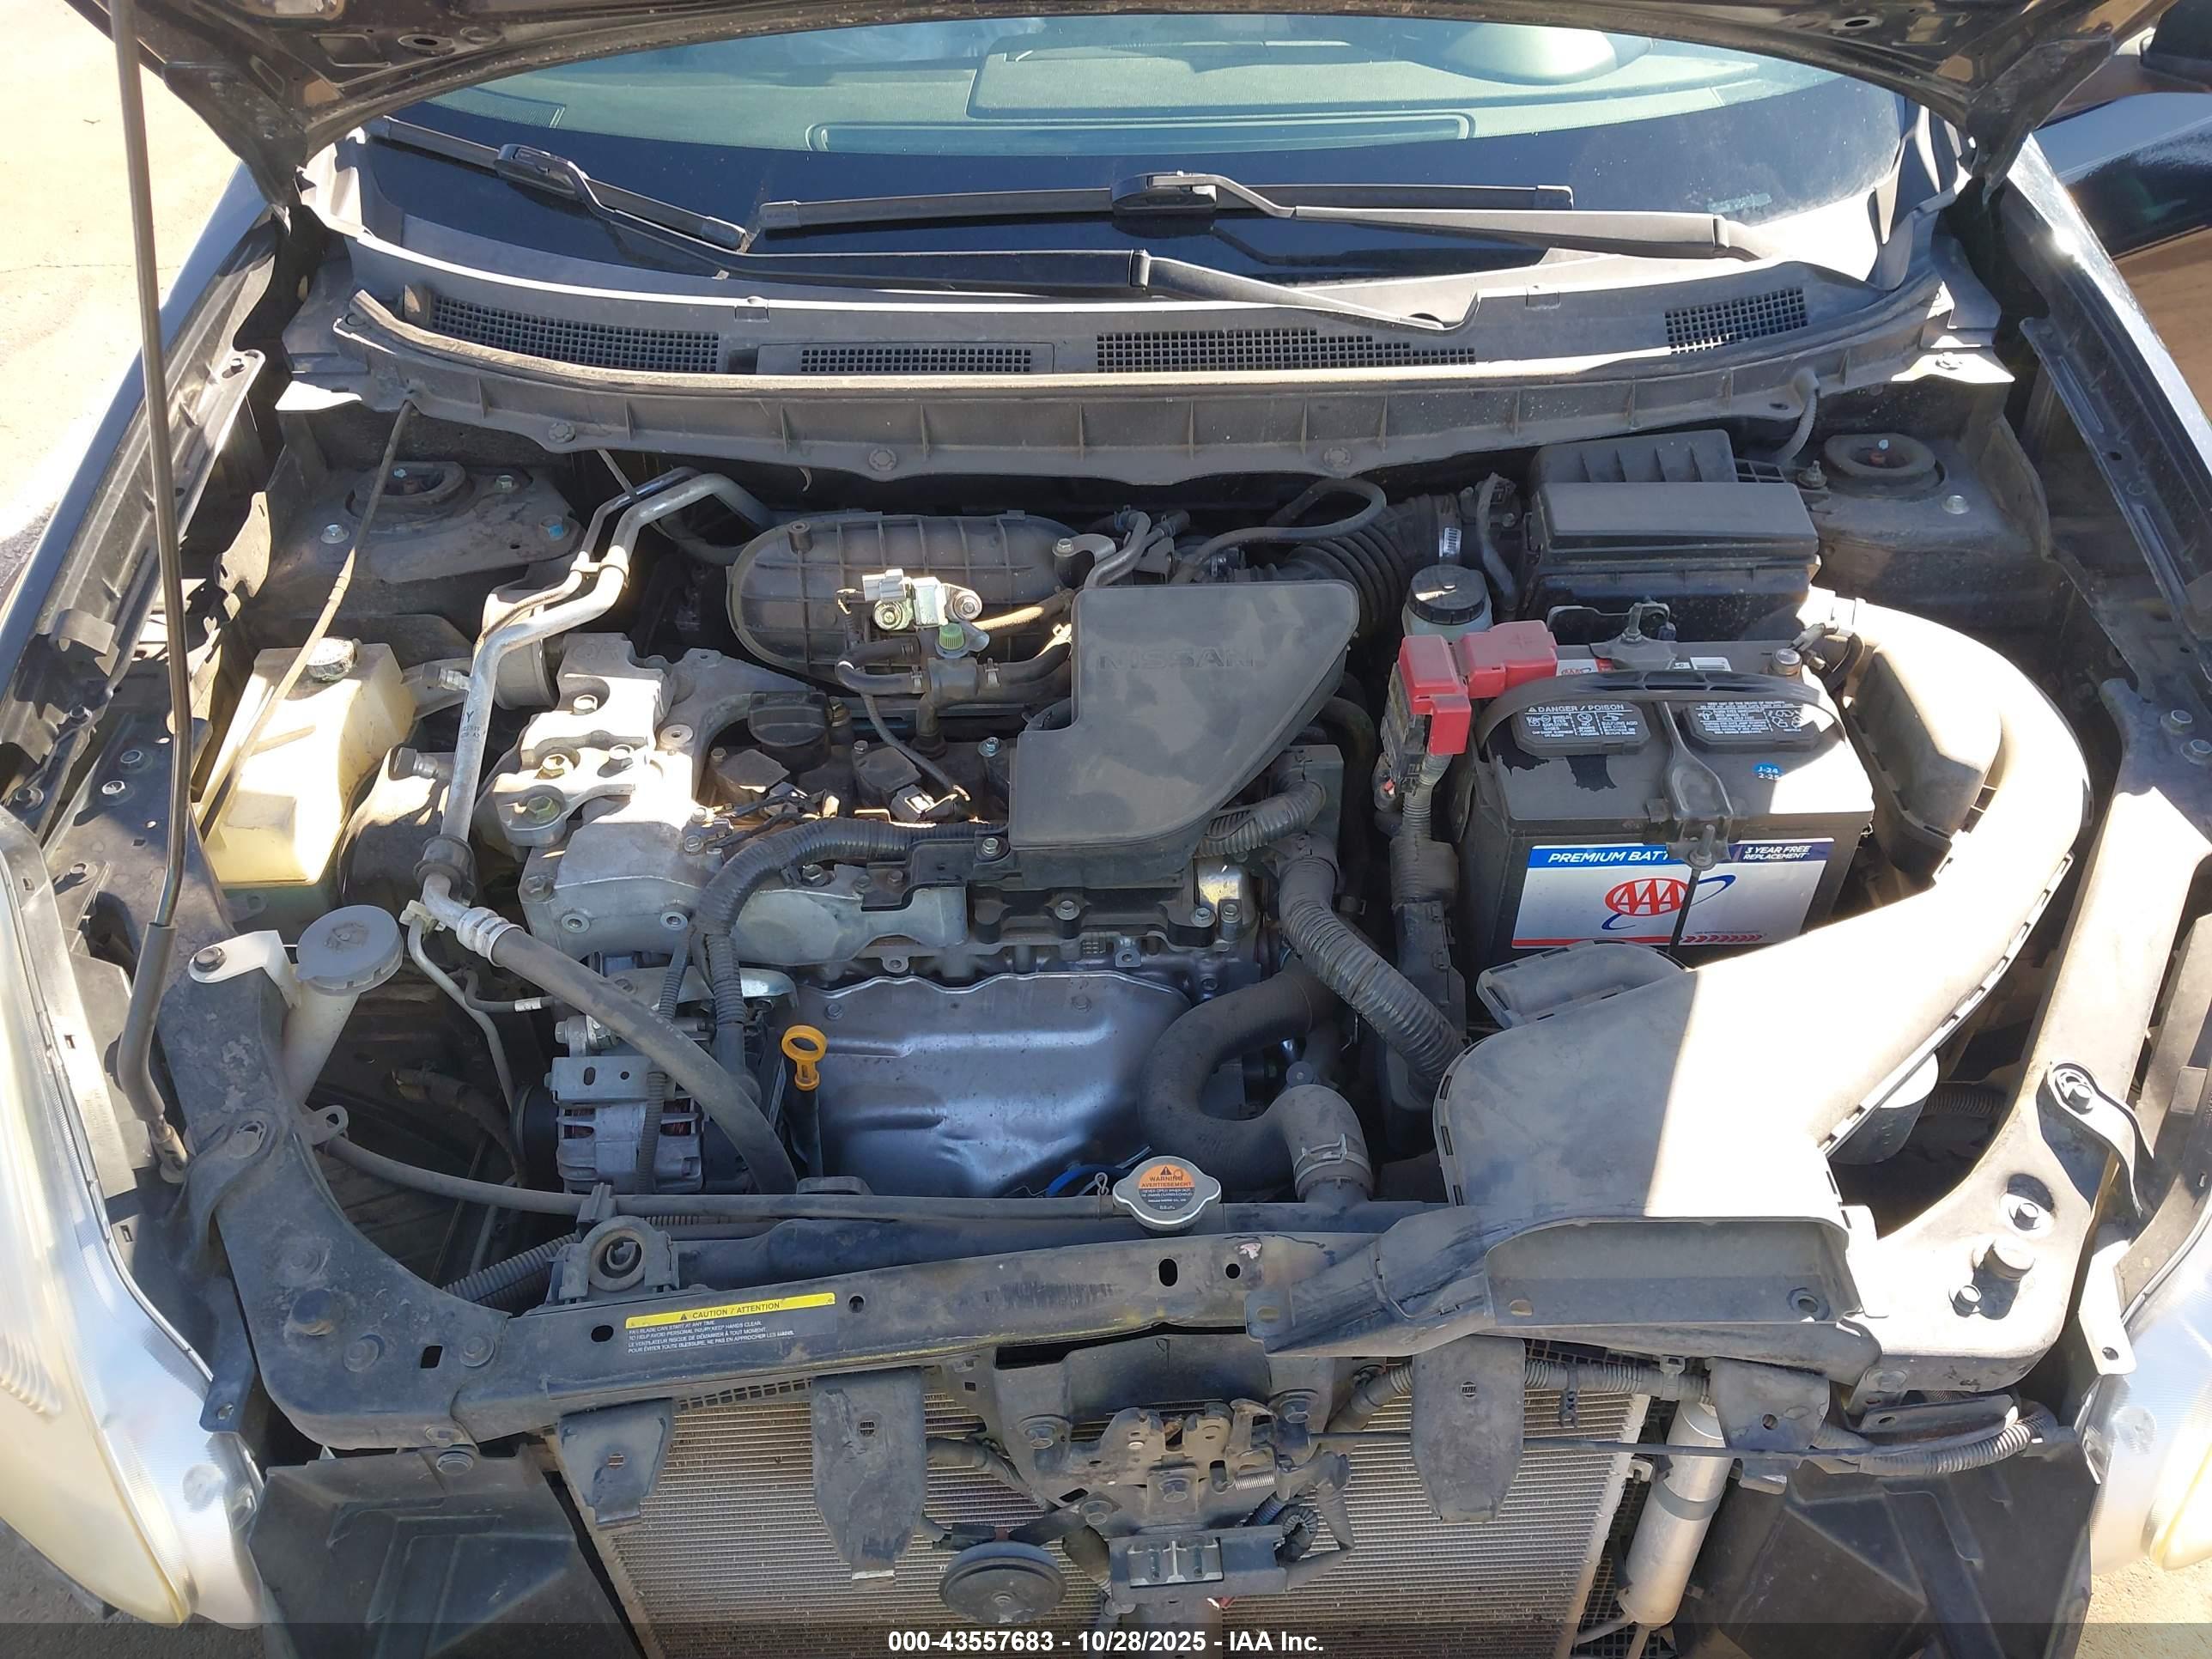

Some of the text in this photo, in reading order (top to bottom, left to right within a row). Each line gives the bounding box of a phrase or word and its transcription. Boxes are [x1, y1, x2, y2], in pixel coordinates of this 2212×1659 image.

[1099, 647, 1255, 670] NISSAN
[1538, 704, 1578, 713] DANGER
[1547, 851, 1627, 863] PREMIUM
[1613, 878, 1683, 915] AAA
[692, 1308, 728, 1319] CAUTION
[738, 1302, 780, 1313] ATTENTION
